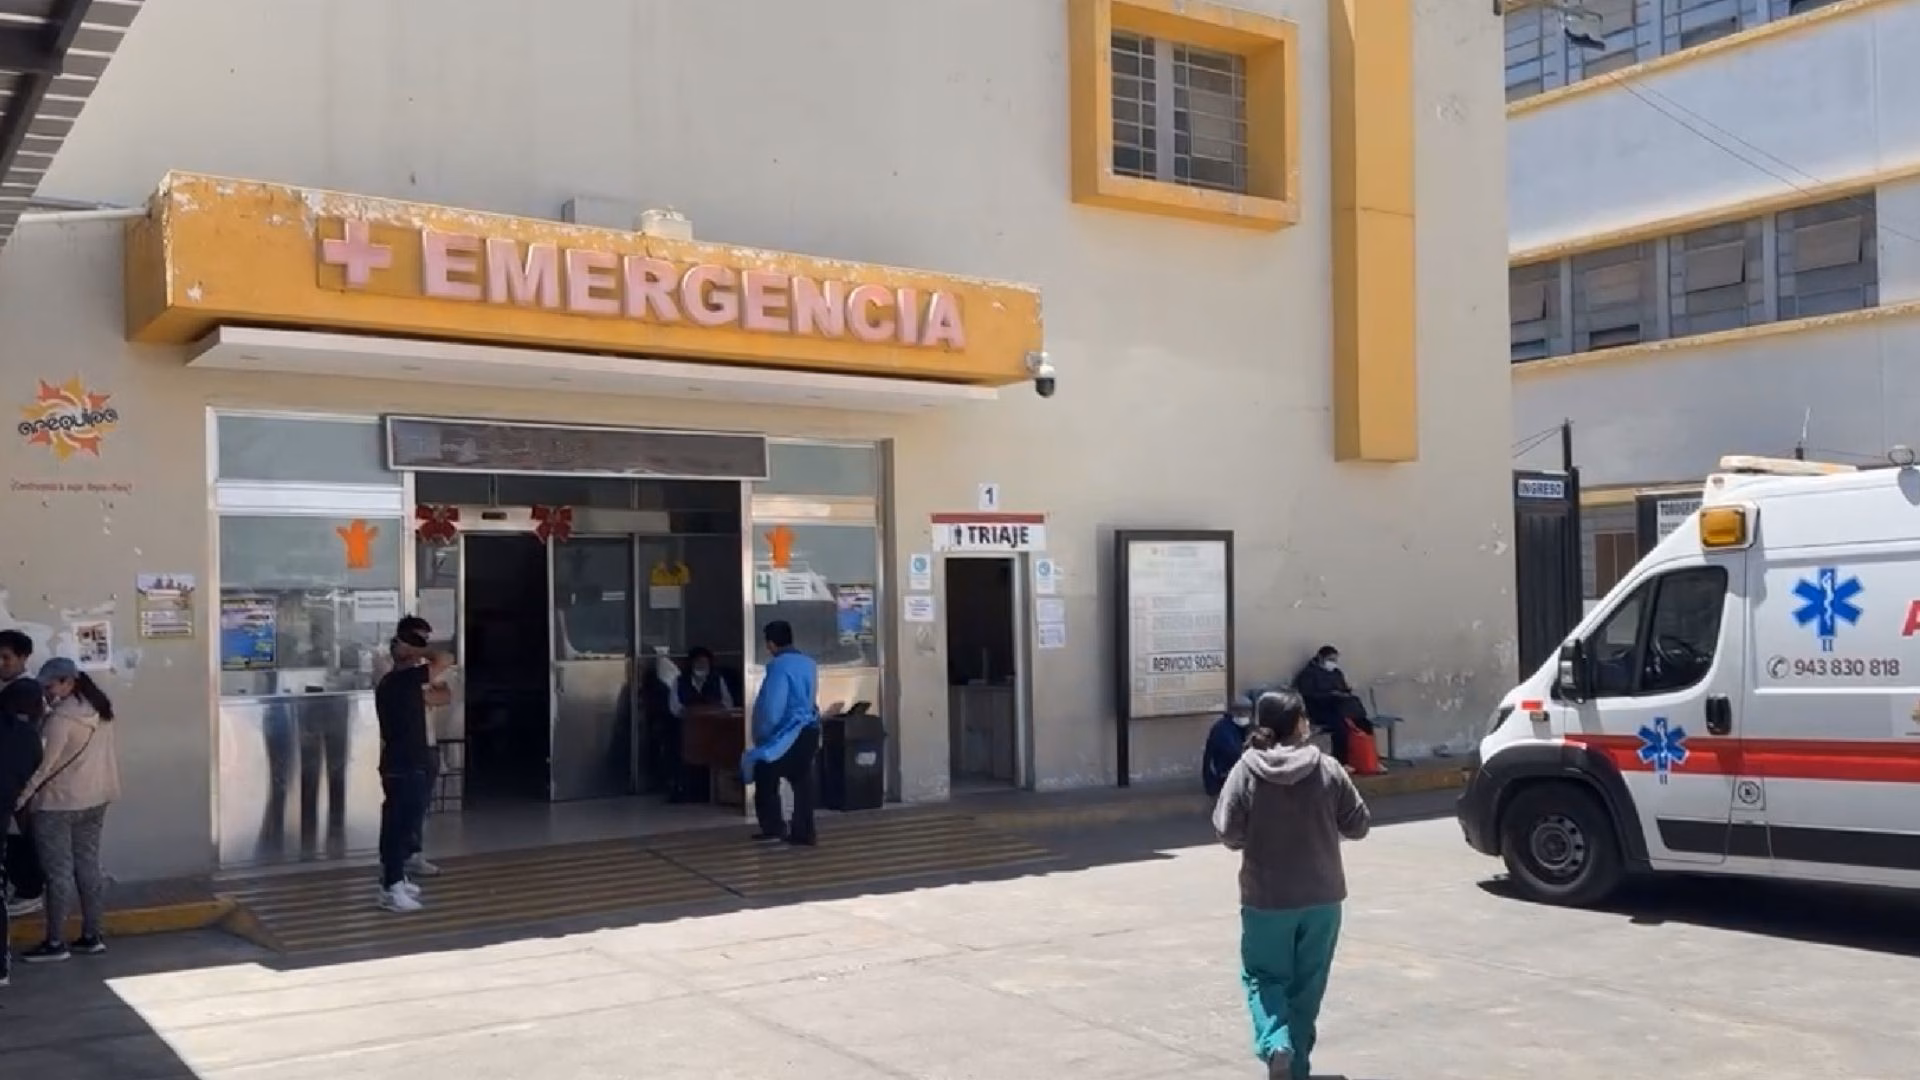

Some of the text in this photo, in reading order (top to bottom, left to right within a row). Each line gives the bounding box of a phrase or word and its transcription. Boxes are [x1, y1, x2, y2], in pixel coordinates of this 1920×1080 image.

[421, 229, 967, 352] EMERGENCIA
[985, 487, 994, 505] 1
[1519, 481, 1563, 497] INGRESO
[967, 525, 1030, 548] TRIAJE
[757, 573, 772, 602] 4
[1195, 654, 1224, 669] SOCIAL
[1794, 658, 1900, 676] 943 830 818
